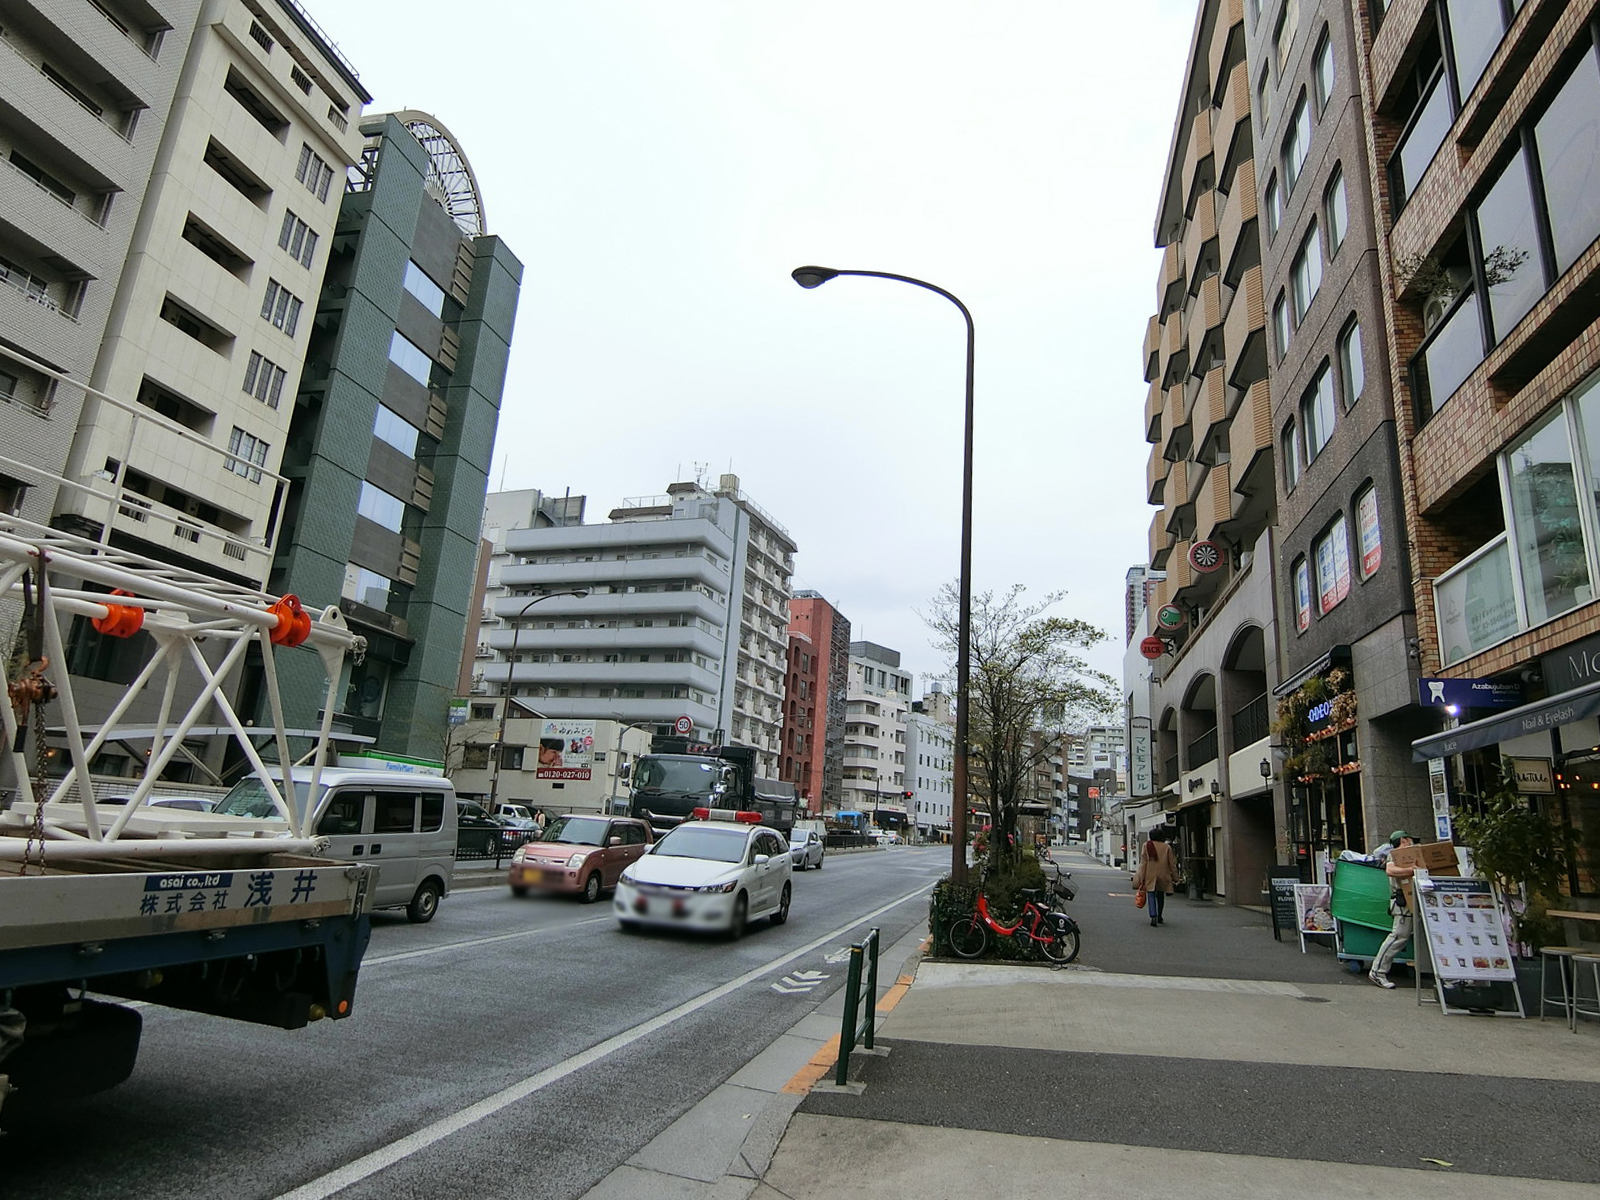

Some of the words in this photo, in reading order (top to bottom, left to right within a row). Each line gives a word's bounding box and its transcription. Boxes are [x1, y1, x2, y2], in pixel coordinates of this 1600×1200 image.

[679, 720, 689, 730] 50
[1522, 716, 1537, 731] Nail
[1537, 715, 1544, 727] &
[1545, 706, 1574, 727] Eyelash
[385, 761, 415, 774] FamilyMart
[1135, 735, 1149, 791] マドモアゼル
[159, 873, 185, 889] asai
[139, 890, 229, 917] 株式会社
